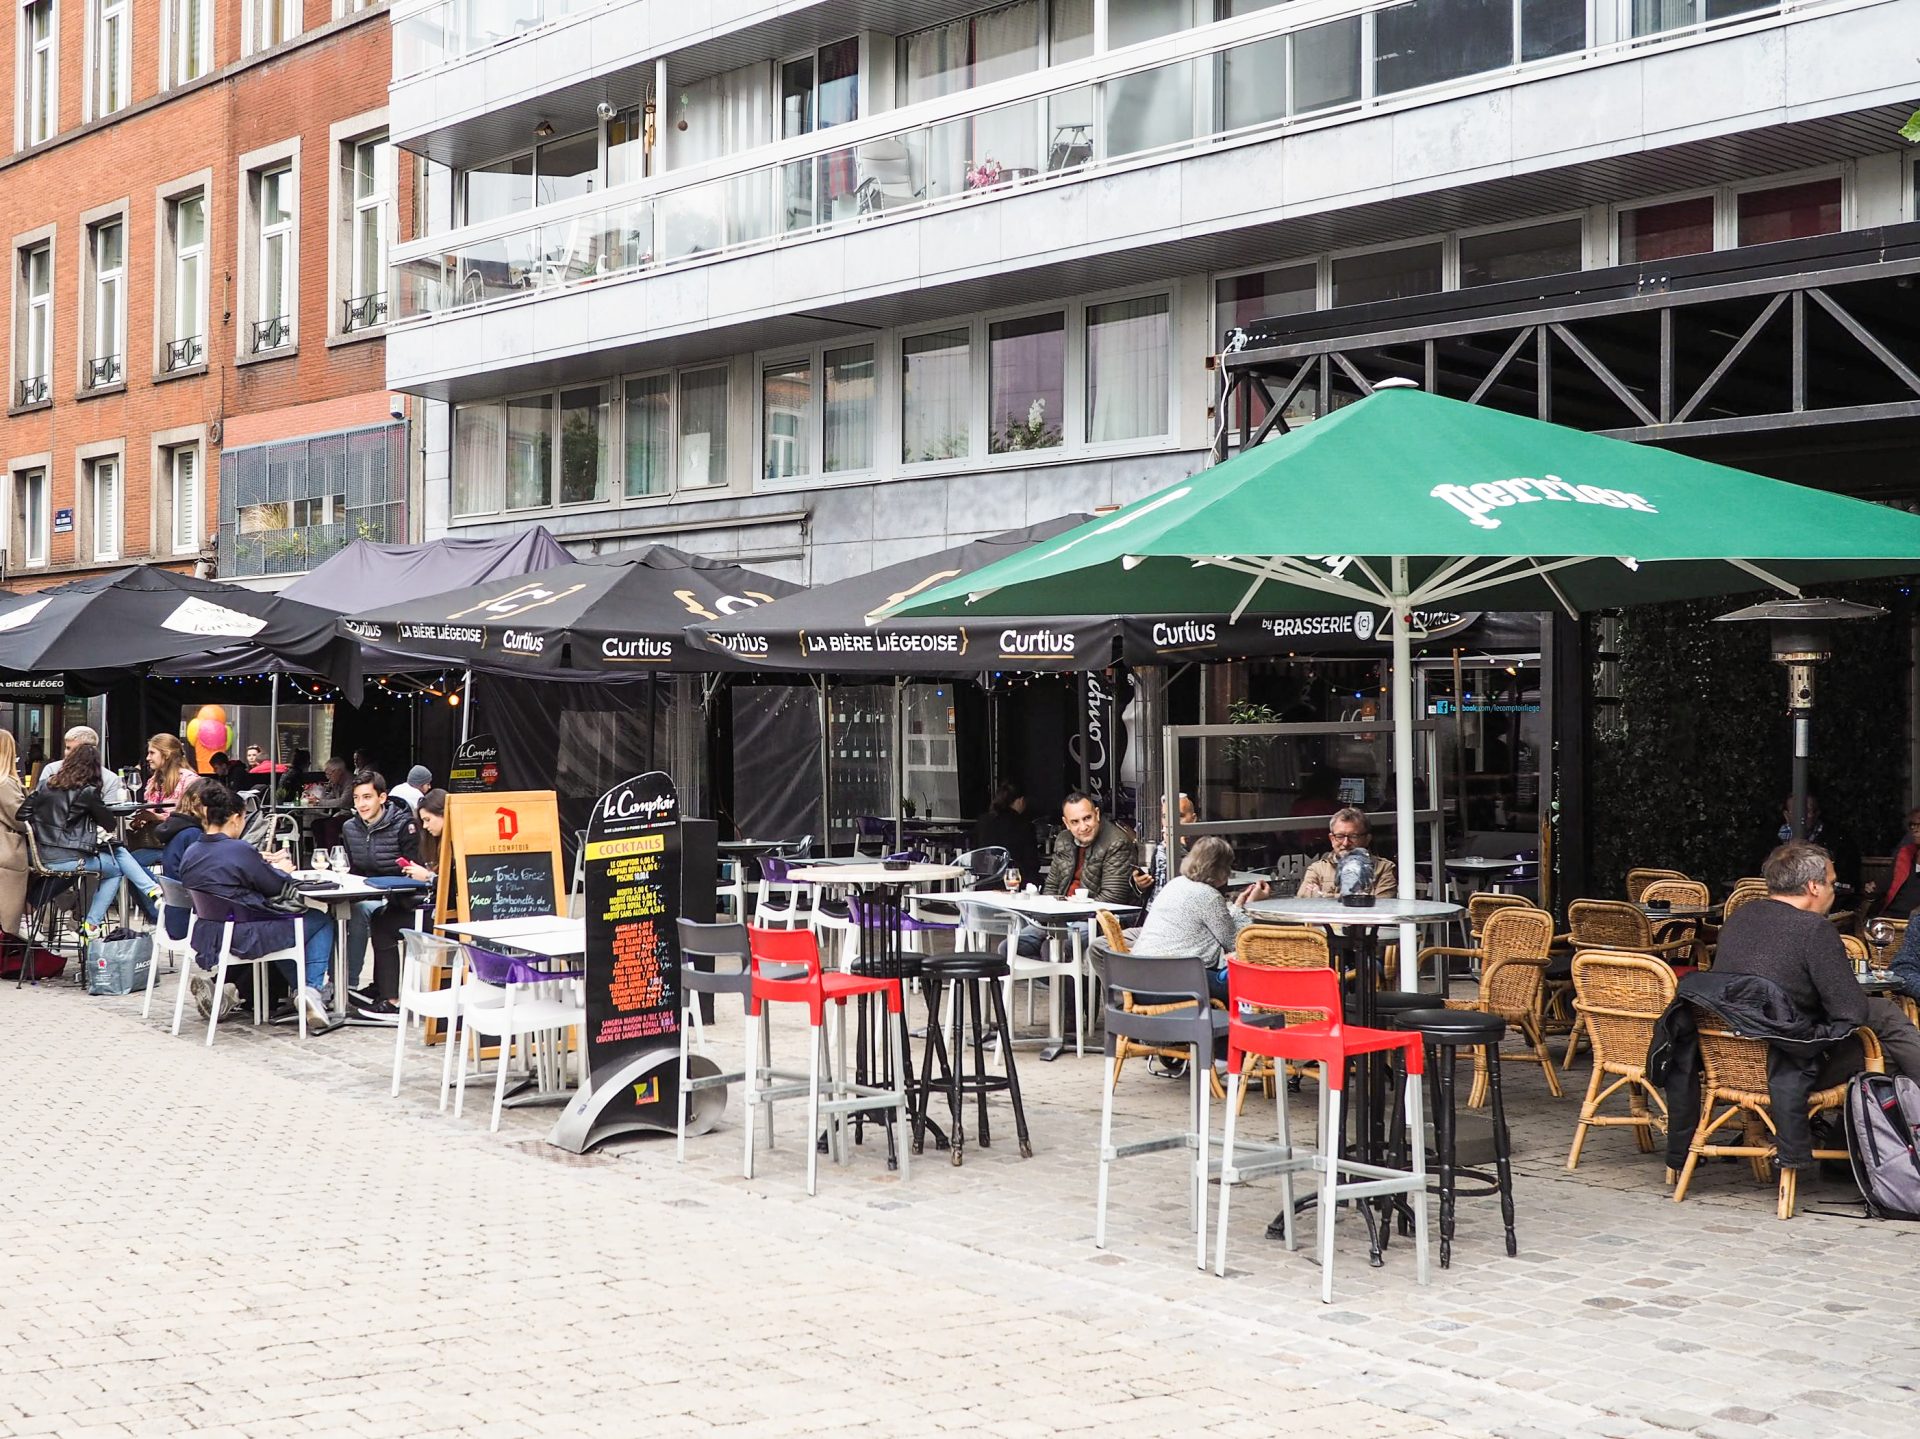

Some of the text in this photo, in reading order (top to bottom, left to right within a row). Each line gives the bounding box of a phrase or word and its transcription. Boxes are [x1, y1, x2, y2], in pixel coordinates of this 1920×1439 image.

[400, 623, 481, 643] LA BIÈRE LIÉGEOISE
[1153, 620, 1216, 645] Curtius
[1261, 618, 1272, 630] by
[1273, 615, 1353, 636] BRASSERIE
[503, 630, 545, 652] Curtius
[602, 638, 672, 656] Curtius
[807, 632, 958, 652] LA BIÈRE LIÉGEOISE
[1000, 629, 1075, 653] Curtius
[617, 790, 675, 820] Comptoir
[600, 838, 661, 856] COCKTAILS
